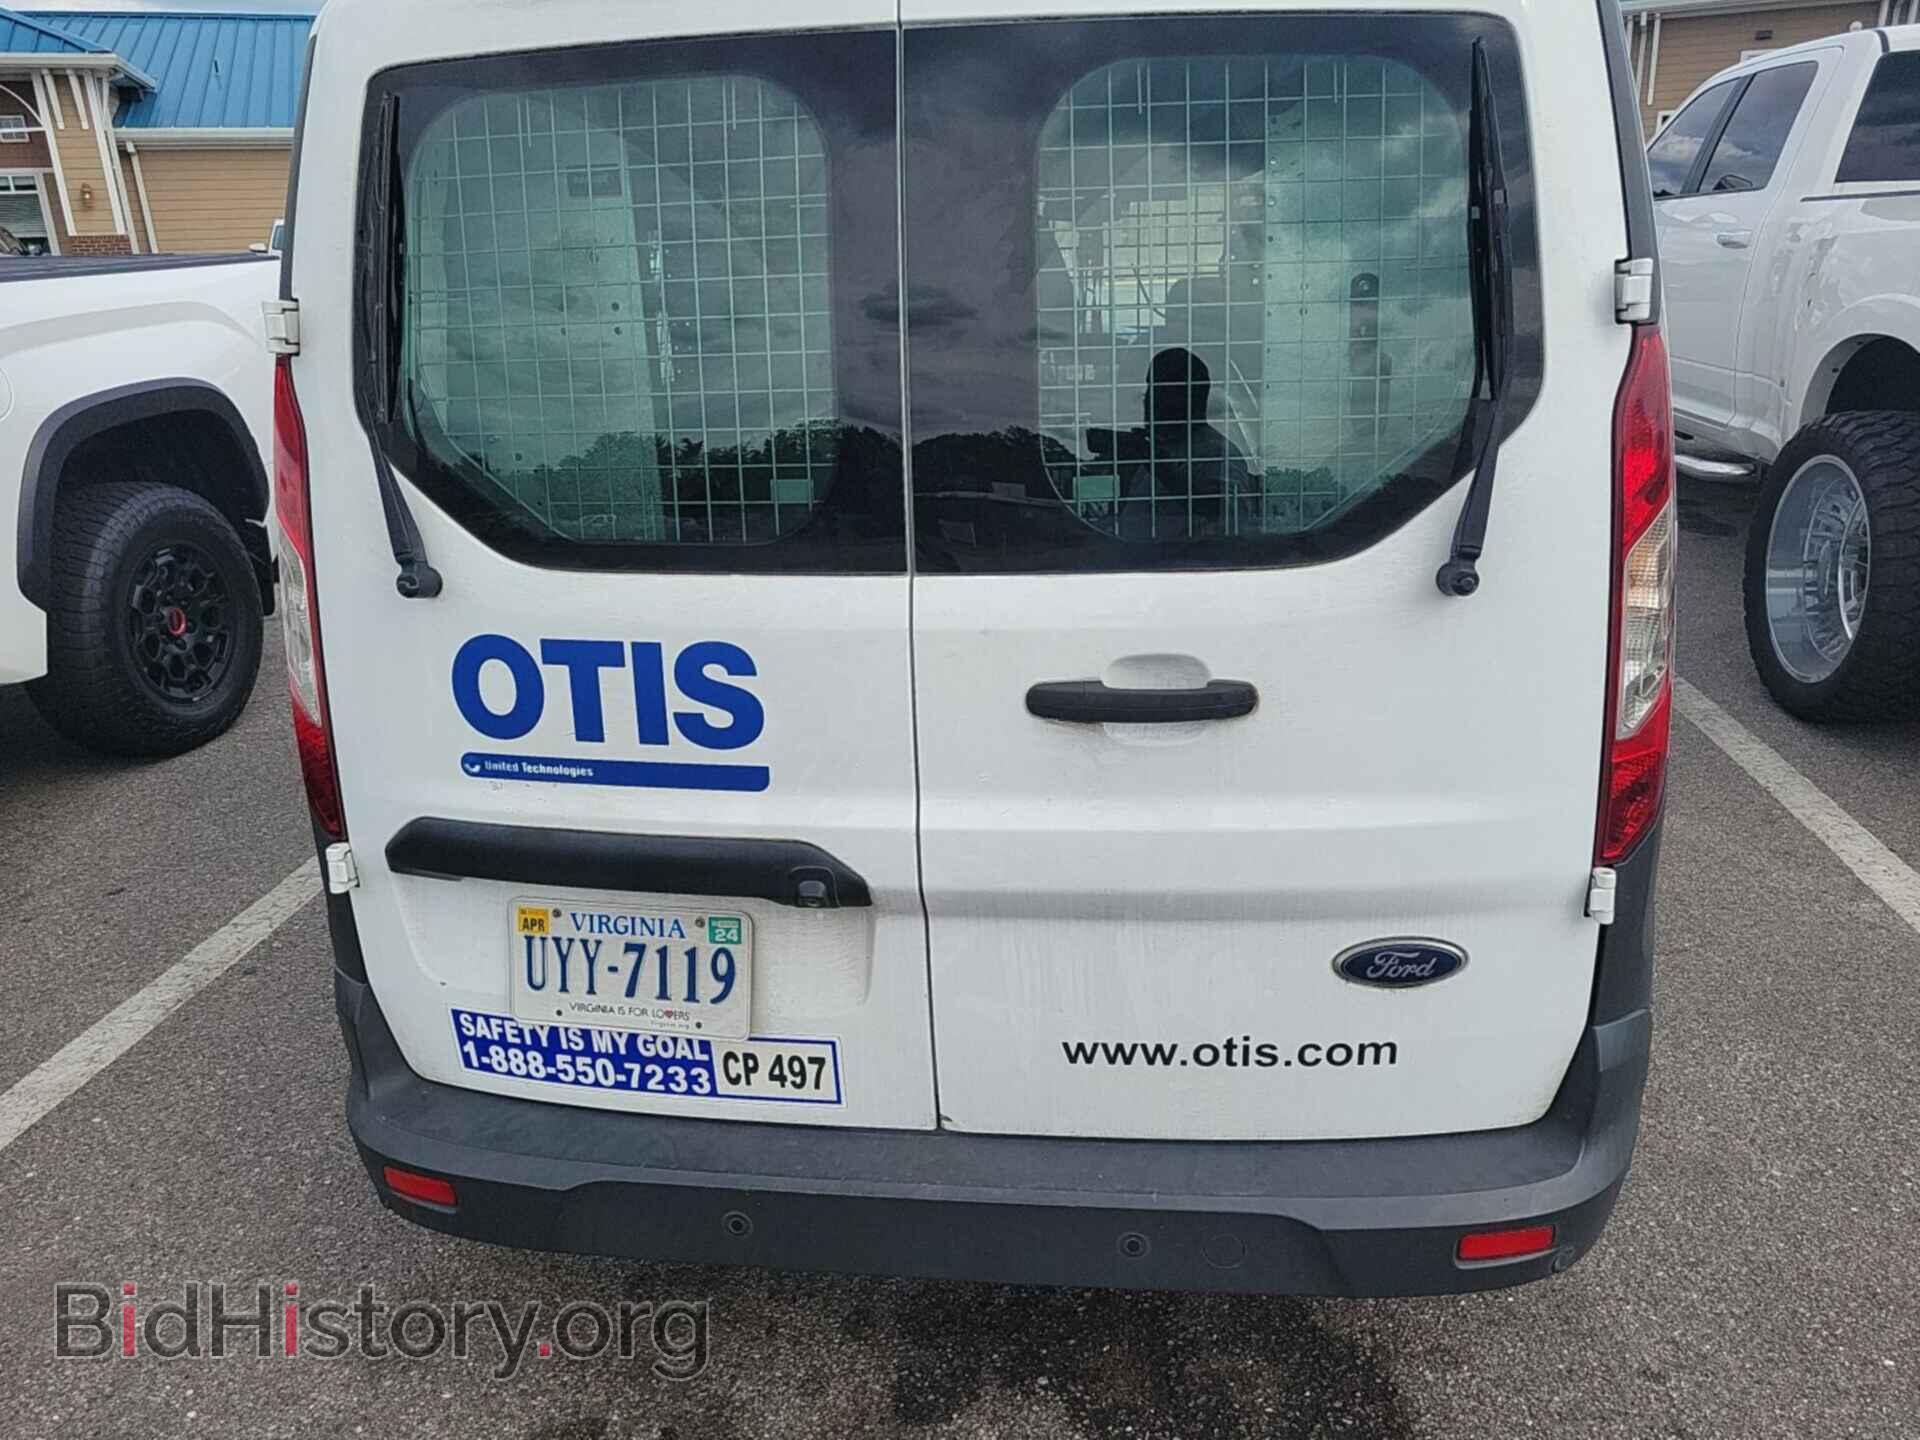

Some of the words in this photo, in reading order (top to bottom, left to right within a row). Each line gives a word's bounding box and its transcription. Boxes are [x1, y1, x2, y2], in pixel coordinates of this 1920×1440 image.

[452, 633, 765, 751] OTIS
[484, 760, 519, 773] United
[521, 761, 594, 778] Technologies
[522, 917, 546, 933] APR
[570, 912, 687, 940] VIRGINIA
[715, 928, 739, 942] 24
[523, 935, 737, 1005] UYY-7119
[1366, 951, 1438, 978] Ford
[568, 1002, 616, 1016] VIRGINIA
[617, 1006, 627, 1016] IS
[628, 1006, 649, 1018] FOR
[459, 1014, 550, 1048] SAFETY
[559, 1027, 585, 1051] IS
[590, 1030, 636, 1055] MY
[636, 1034, 711, 1061] GOAL
[1062, 1035, 1399, 1067] www.otis.com
[462, 1041, 712, 1095] 1-888-550-7233
[722, 1050, 760, 1085] CP
[767, 1053, 827, 1091] 497
